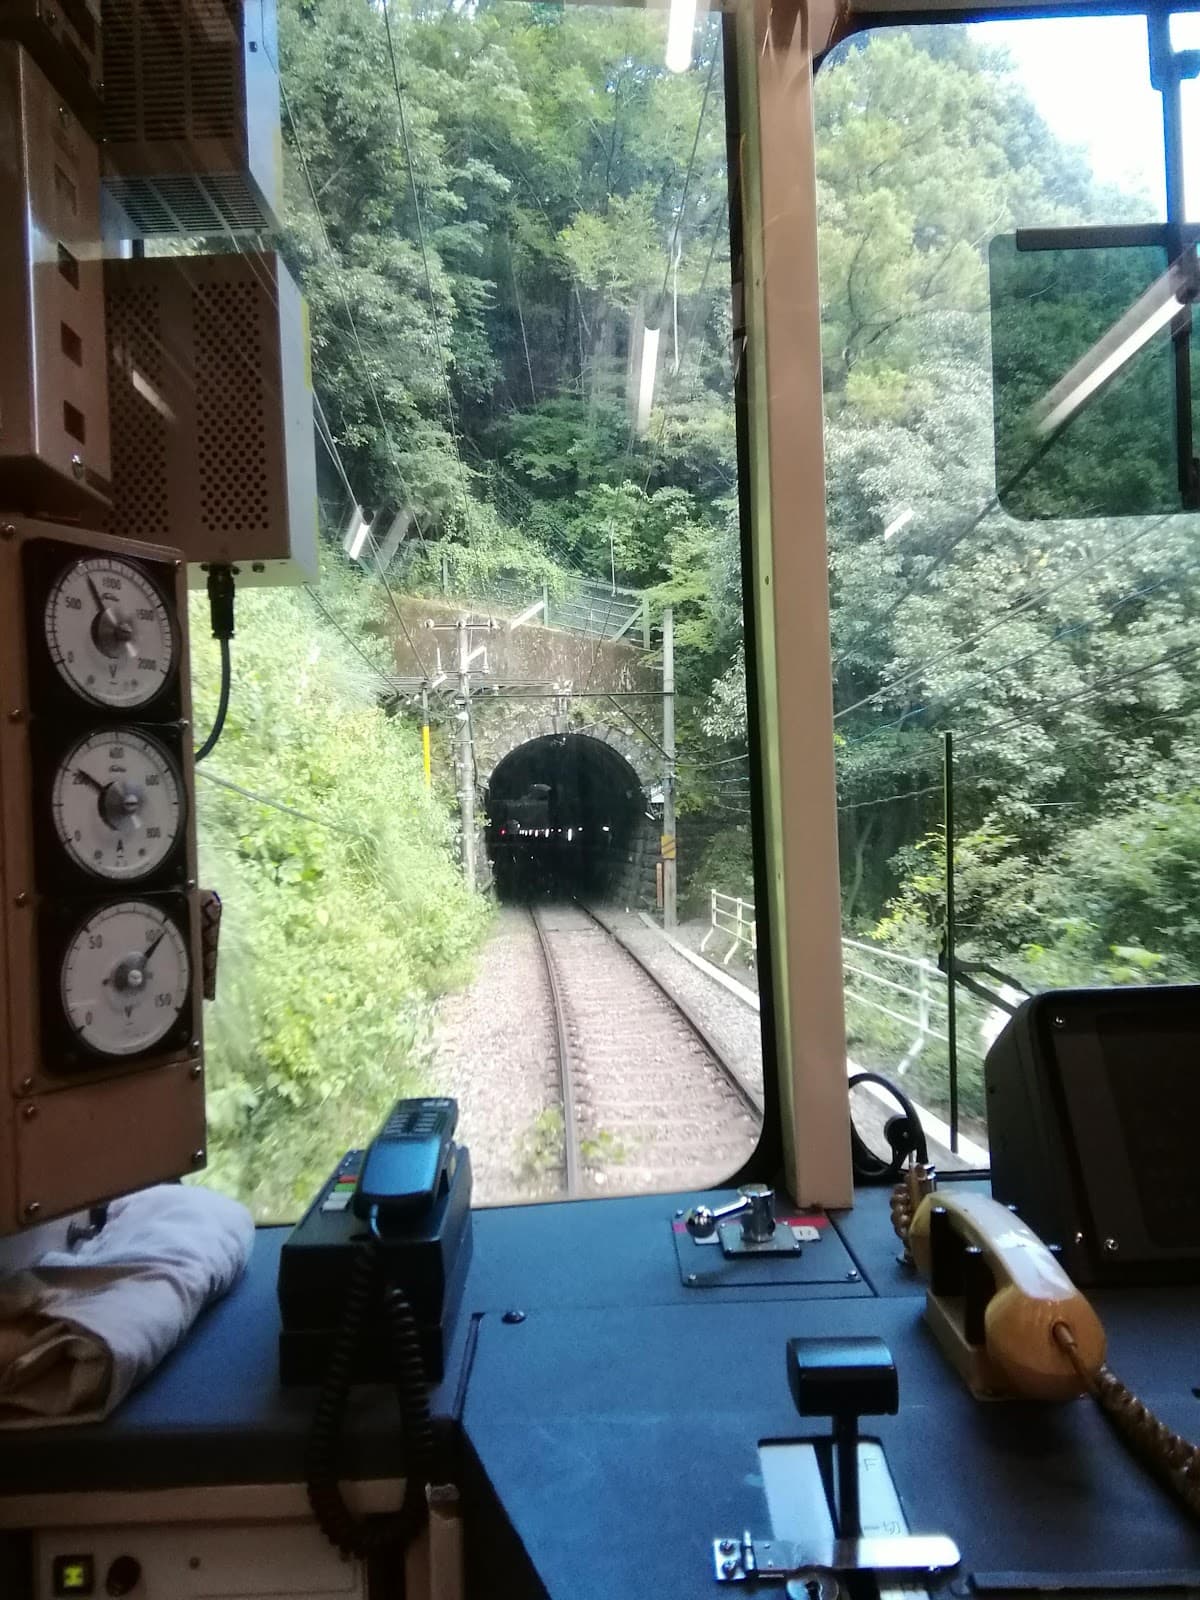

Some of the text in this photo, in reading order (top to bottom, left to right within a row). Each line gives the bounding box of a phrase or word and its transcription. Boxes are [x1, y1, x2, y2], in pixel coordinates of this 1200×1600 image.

[66, 596, 81, 609] 500
[68, 651, 75, 664] 0
[109, 664, 118, 678] V
[117, 839, 124, 852] A
[89, 935, 103, 949] 50
[154, 993, 171, 1007] 150
[86, 1011, 93, 1026] 0
[124, 1006, 133, 1018] V
